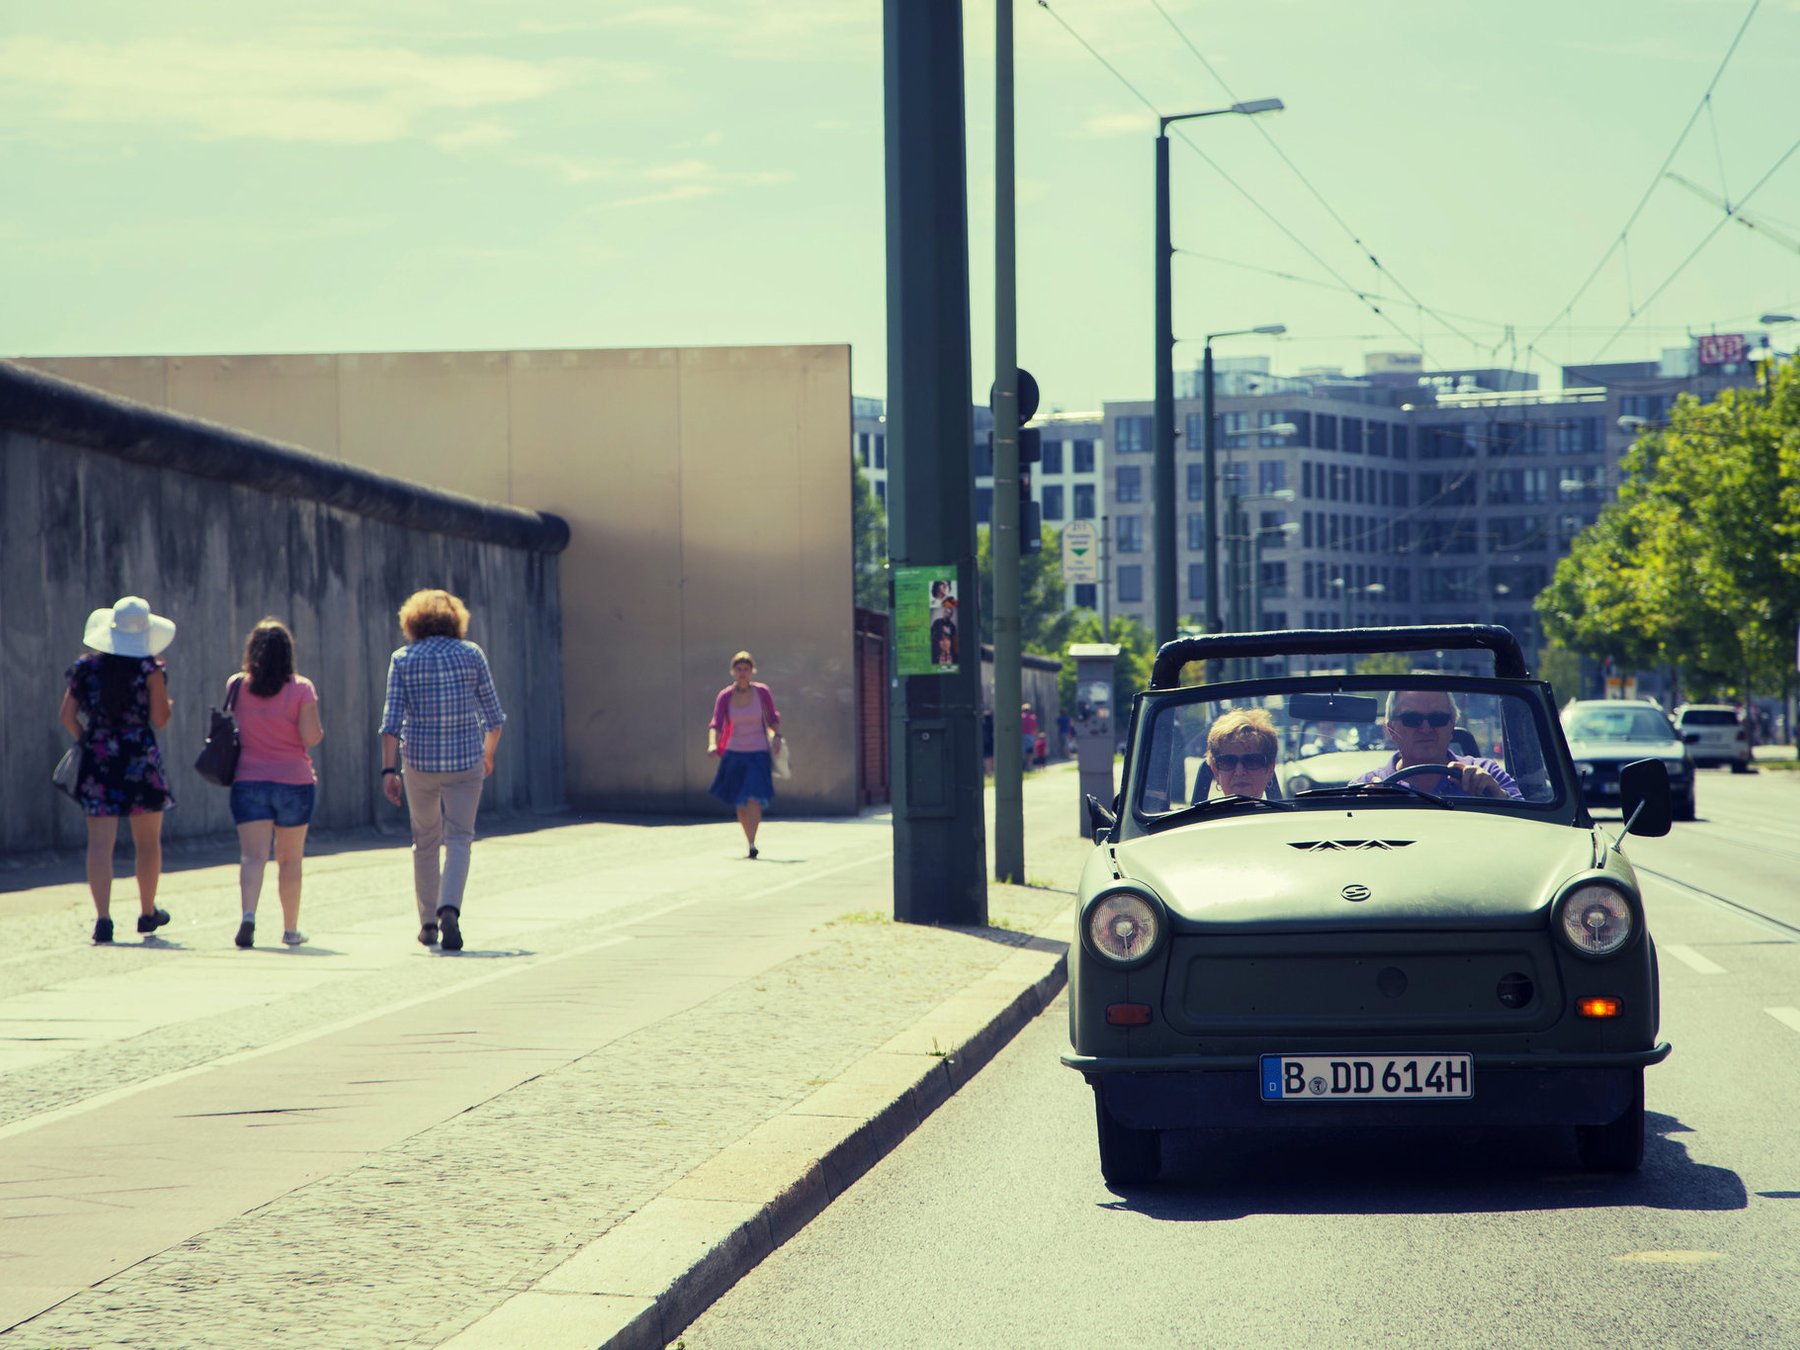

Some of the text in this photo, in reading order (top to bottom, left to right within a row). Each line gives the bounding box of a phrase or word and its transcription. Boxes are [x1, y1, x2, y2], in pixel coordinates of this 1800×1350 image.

[1269, 1082, 1277, 1091] D
[1284, 1060, 1468, 1094] B DD 614H
